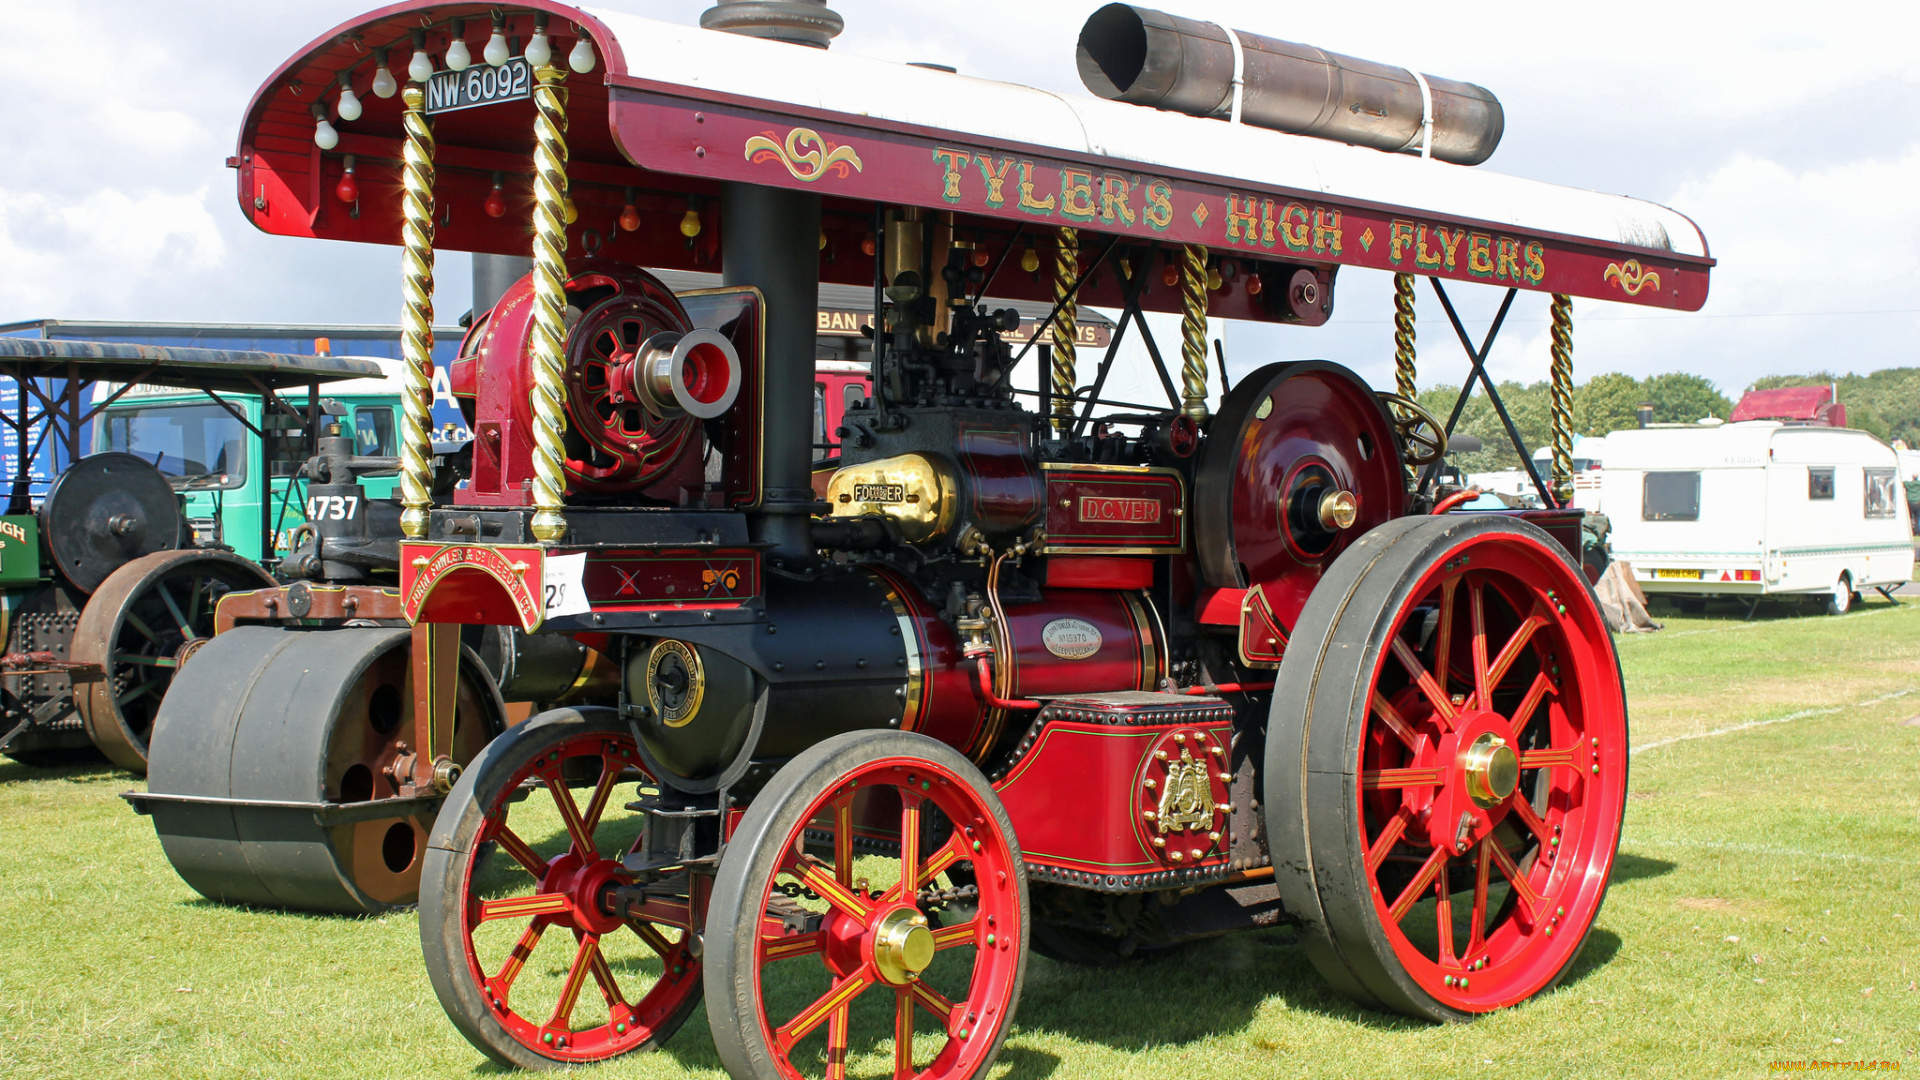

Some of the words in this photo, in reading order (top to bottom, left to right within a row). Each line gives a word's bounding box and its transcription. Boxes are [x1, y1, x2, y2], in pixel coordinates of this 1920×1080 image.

[933, 146, 1174, 232] TYLER'S
[1223, 192, 1343, 257] HIGH
[1388, 217, 1546, 287] FLYERS
[817, 311, 857, 330] BAN
[307, 495, 359, 521] 4737
[1117, 501, 1155, 520] VER
[411, 573, 430, 608] JOHN
[430, 548, 463, 577] FOWLER
[465, 548, 473, 561] &
[734, 974, 765, 1066] DUNLOP
